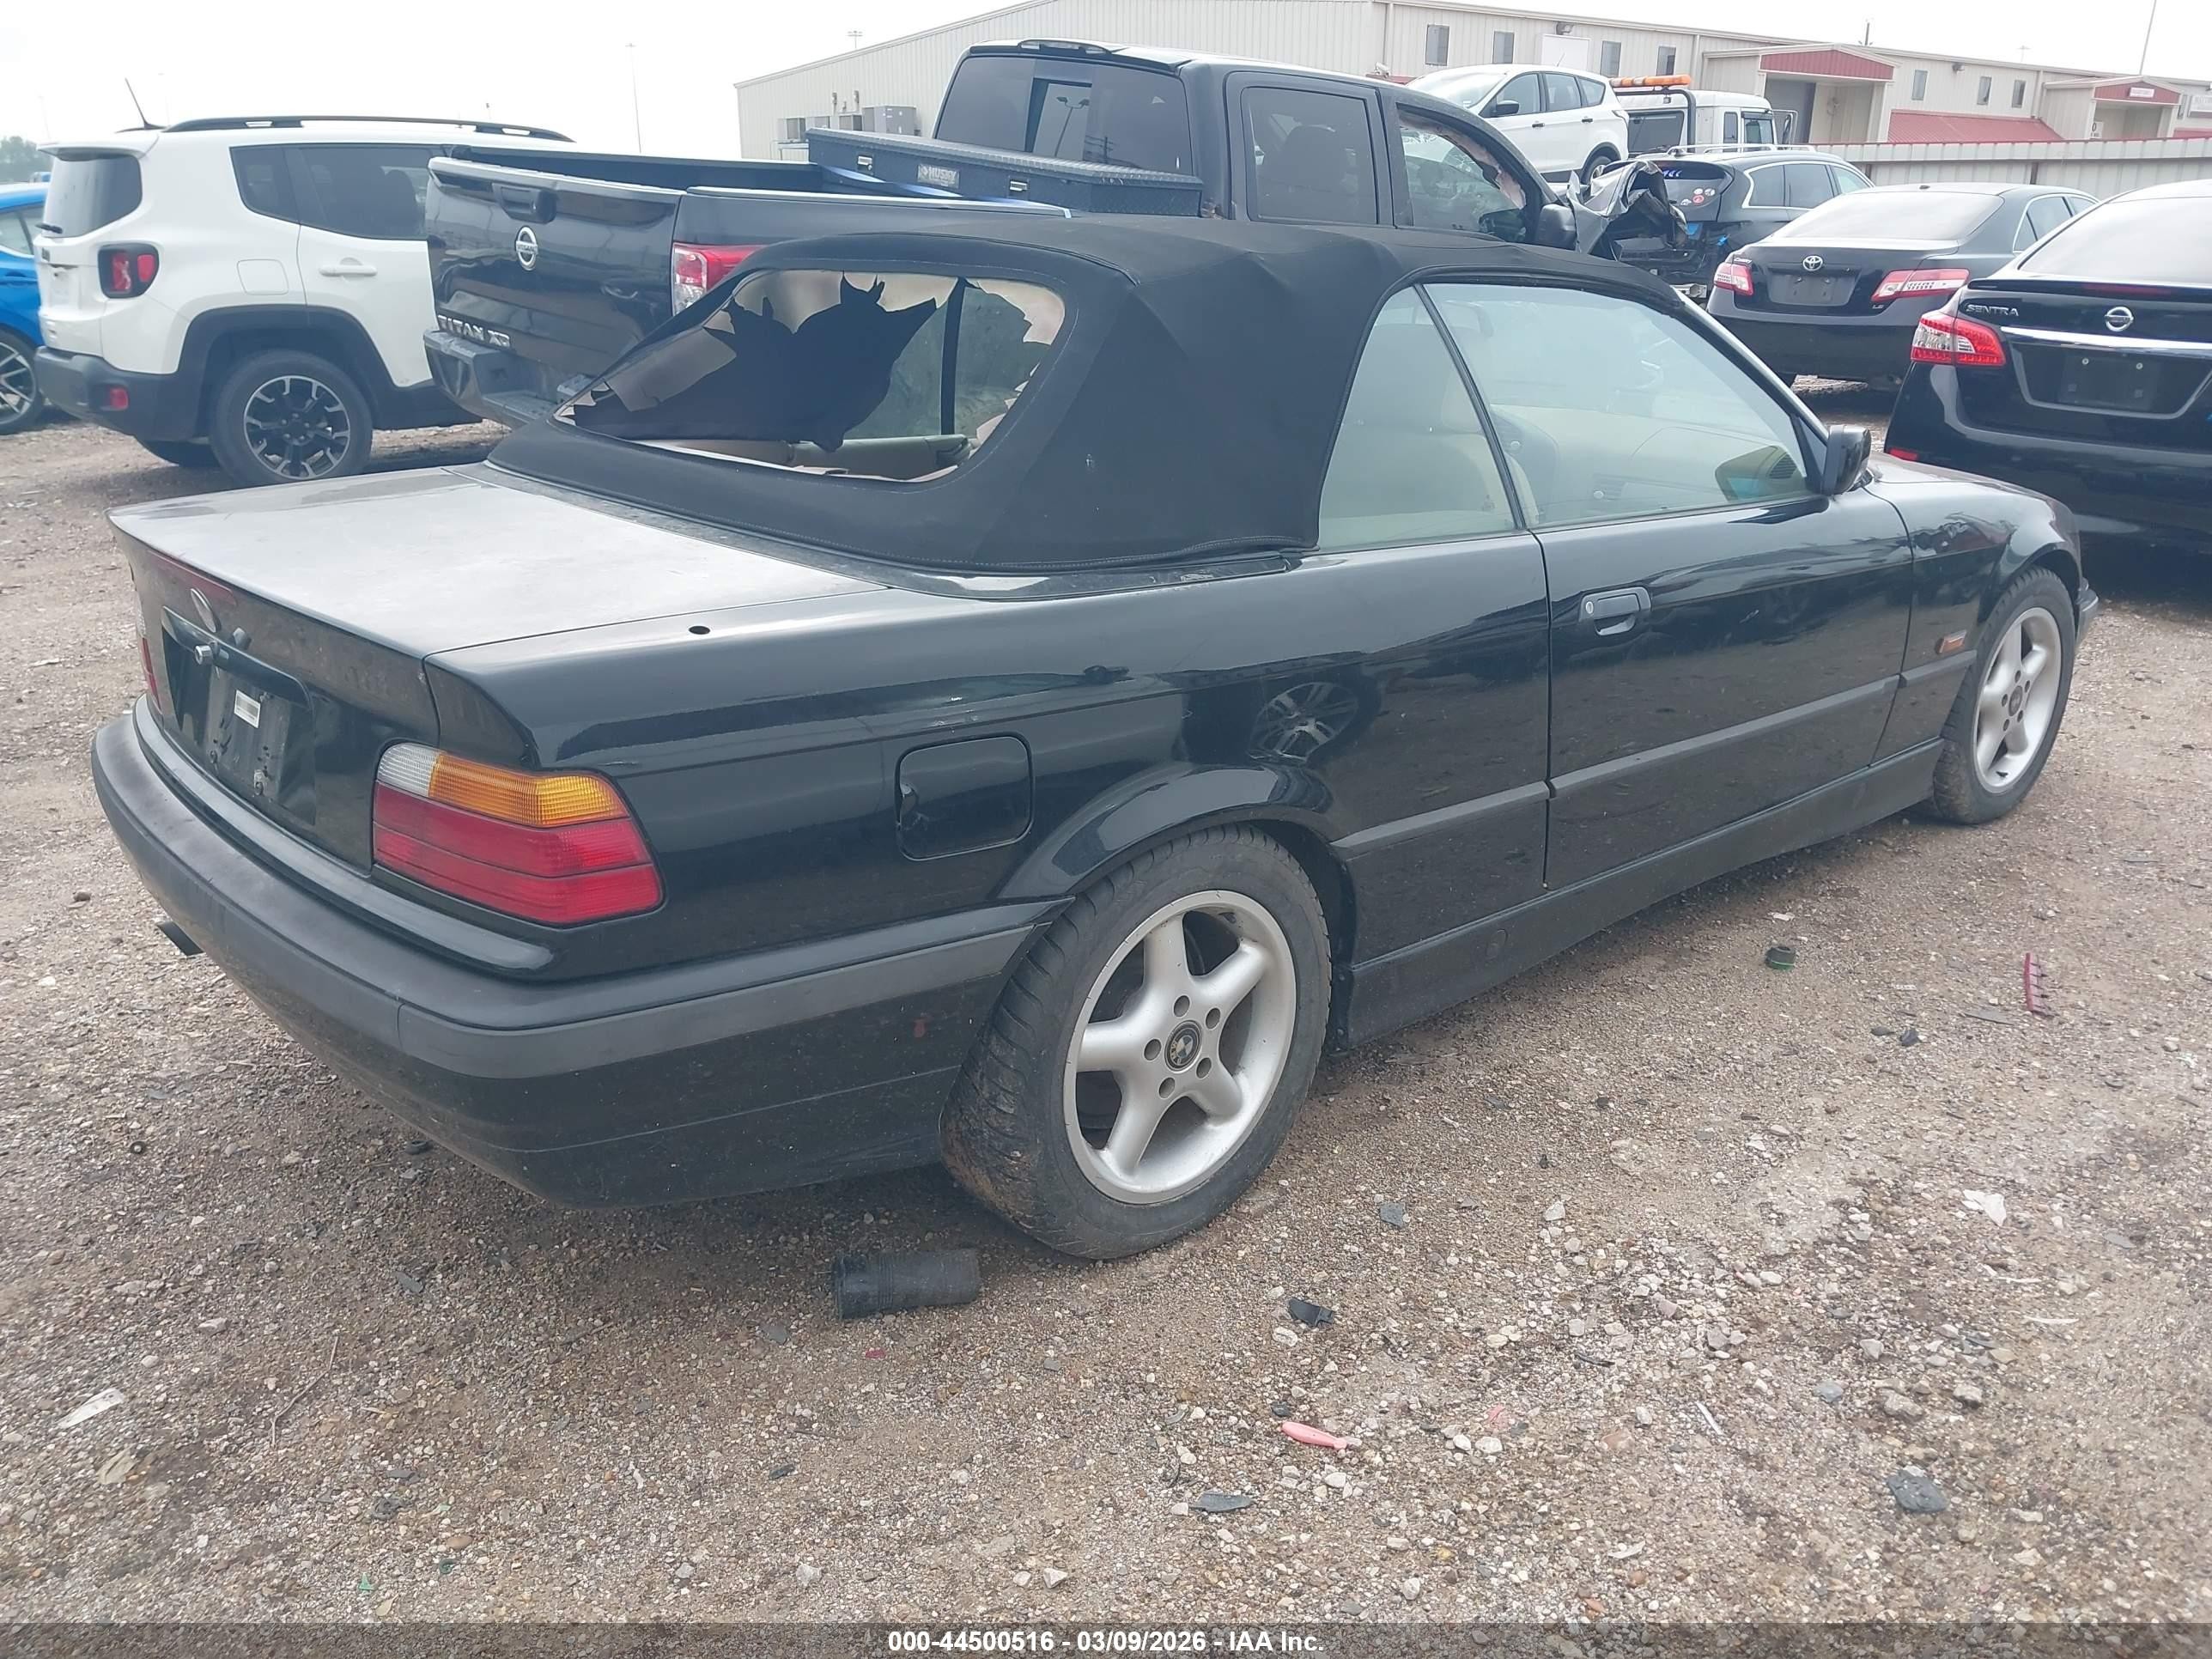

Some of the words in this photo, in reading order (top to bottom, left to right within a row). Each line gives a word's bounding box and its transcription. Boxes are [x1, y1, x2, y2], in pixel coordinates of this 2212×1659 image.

[928, 166, 957, 181] HUSKY
[1966, 304, 2019, 317] SENTRA
[437, 314, 484, 341] TITAN
